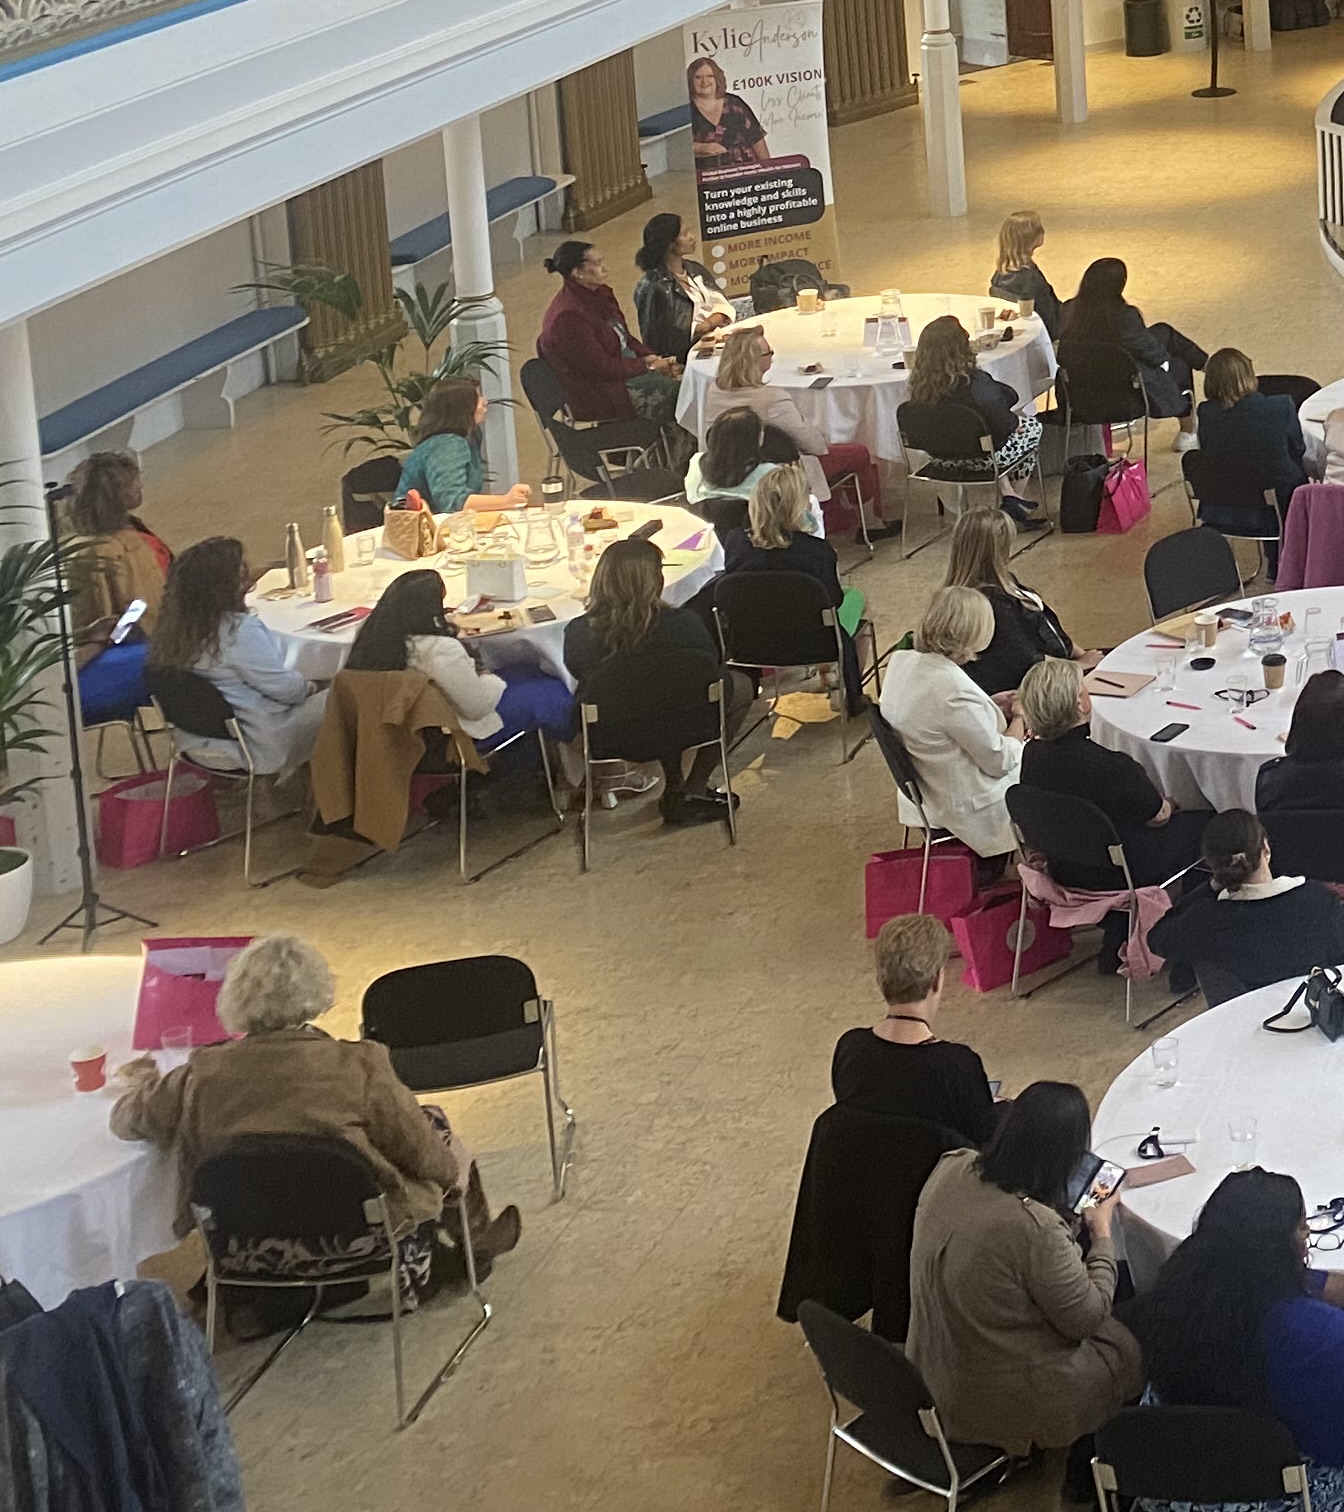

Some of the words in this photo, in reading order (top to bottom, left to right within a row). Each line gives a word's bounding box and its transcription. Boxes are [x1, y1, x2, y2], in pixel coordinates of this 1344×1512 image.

[692, 27, 752, 58] Kylie
[744, 19, 818, 63] Anderson
[732, 74, 773, 91] £100K
[775, 69, 822, 85] VISION
[703, 190, 729, 200] Turn
[729, 185, 752, 198] your
[754, 178, 794, 191] existing
[705, 196, 759, 211] knowledge
[760, 191, 779, 202] and
[781, 187, 807, 198] skills
[706, 212, 727, 223] into
[729, 211, 735, 219] a
[737, 205, 767, 218] highly
[768, 197, 818, 214] profitable
[707, 222, 739, 234] online
[740, 214, 783, 228] business
[727, 238, 762, 254] MORE
[764, 230, 811, 246] INCOME
